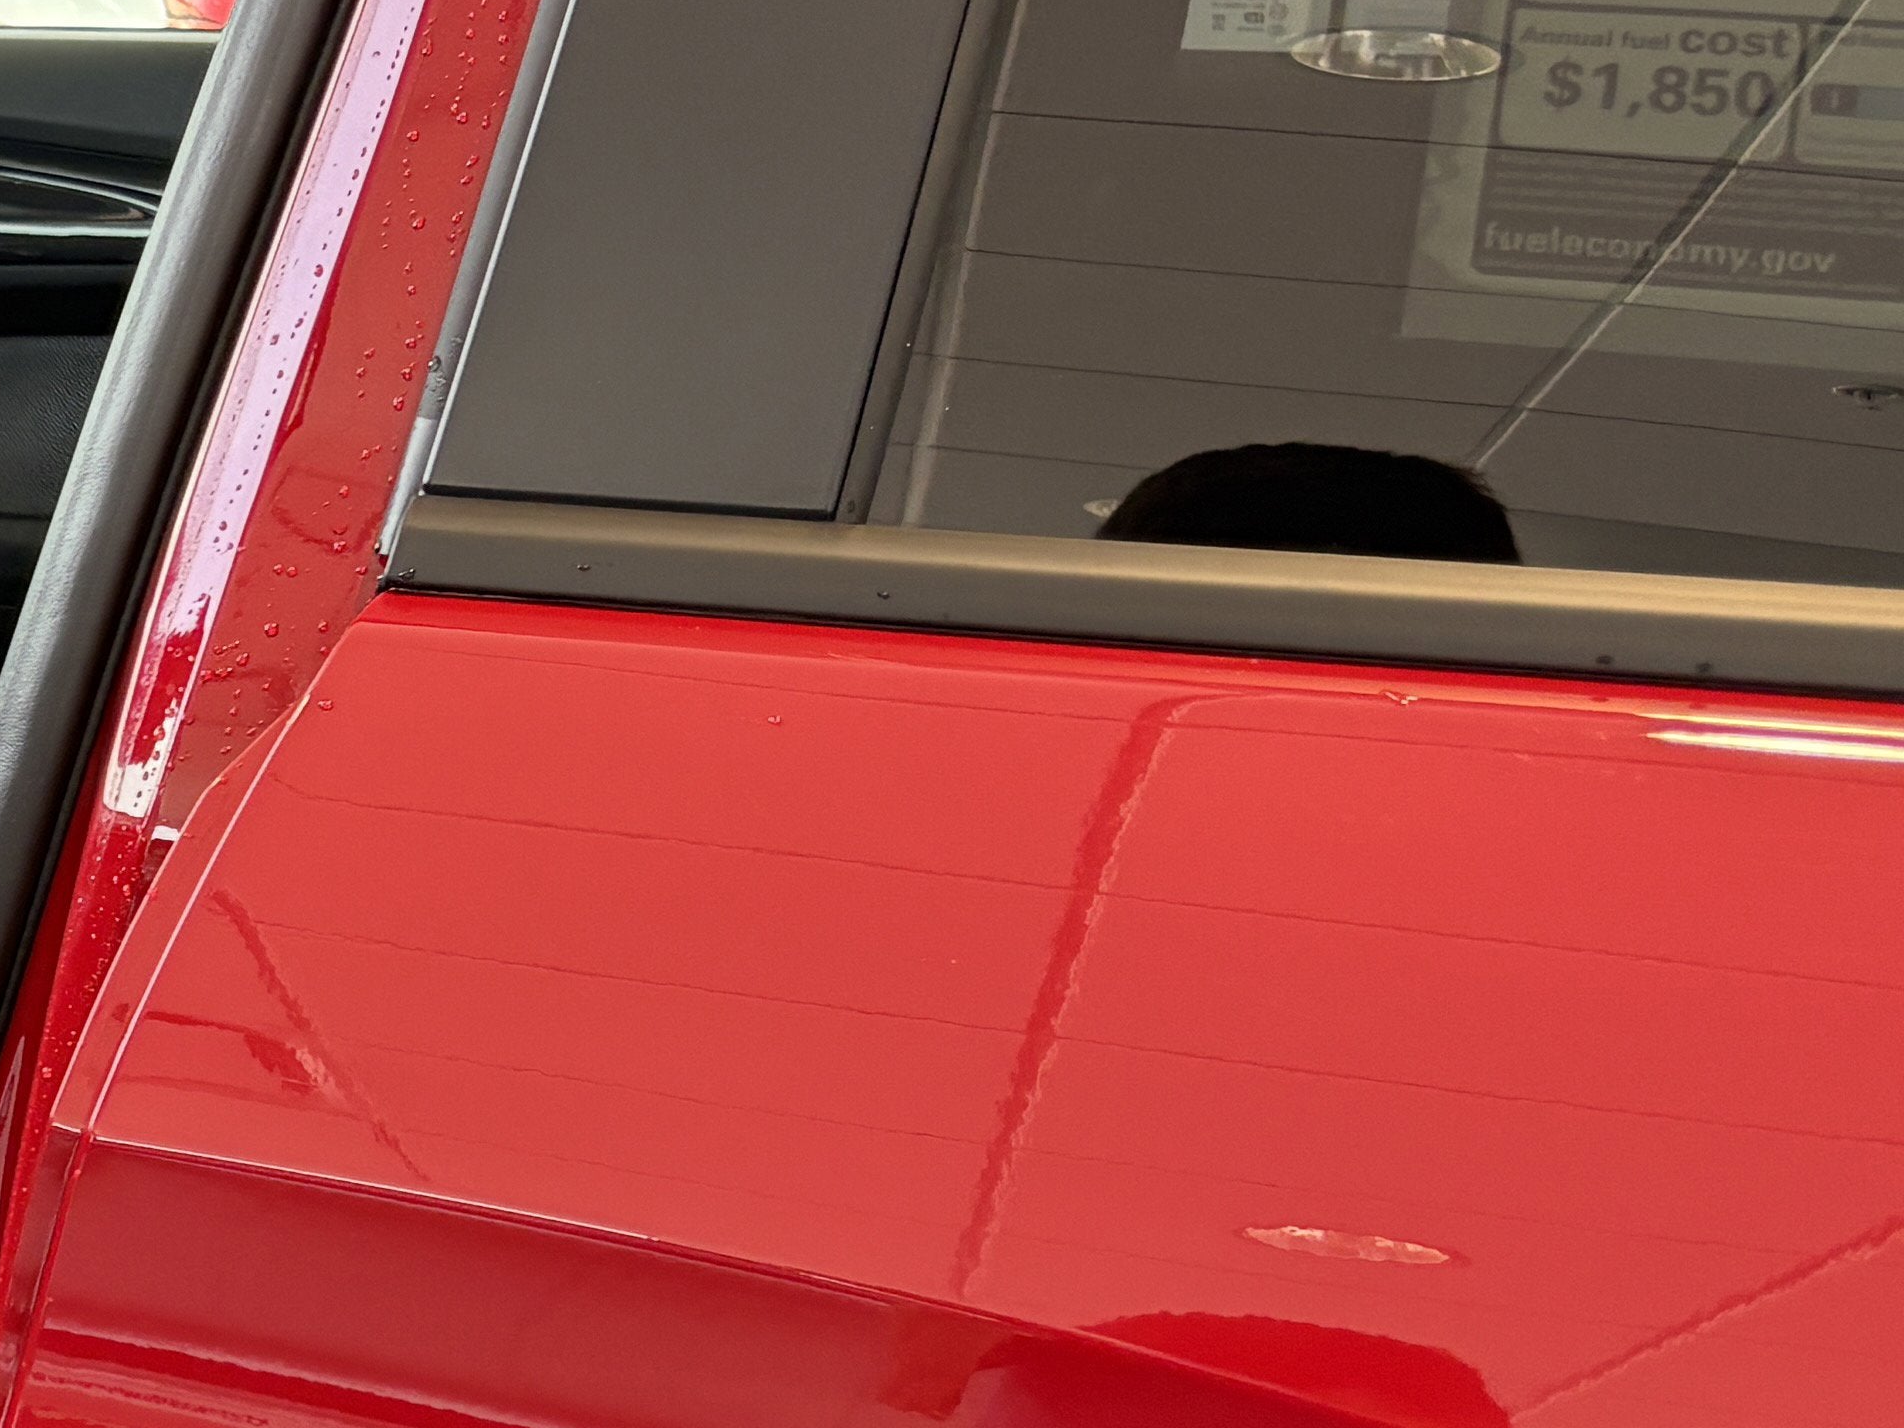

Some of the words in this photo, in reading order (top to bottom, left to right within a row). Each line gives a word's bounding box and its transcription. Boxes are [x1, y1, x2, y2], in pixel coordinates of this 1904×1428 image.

[1520, 27, 1613, 48] Annual
[1622, 30, 1671, 50] fuel
[1678, 27, 1791, 59] cost
[1542, 54, 1776, 119] $1,850
